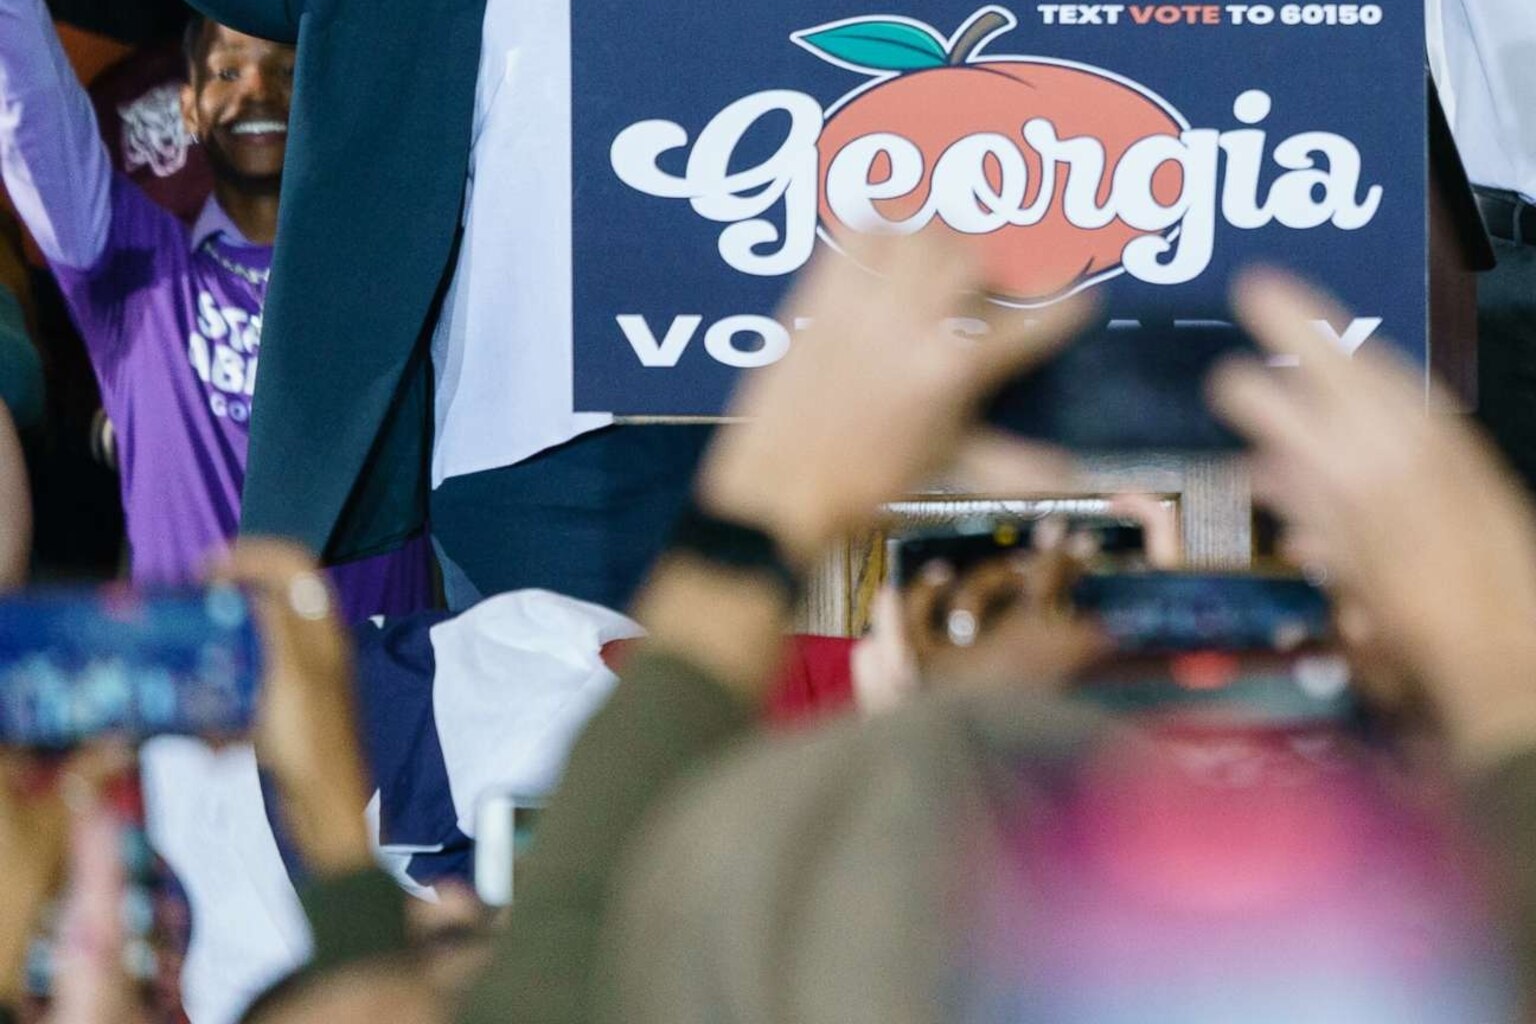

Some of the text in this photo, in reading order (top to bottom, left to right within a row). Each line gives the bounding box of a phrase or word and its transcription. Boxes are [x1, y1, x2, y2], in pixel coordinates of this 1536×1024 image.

[1037, 4, 1383, 25] TEXT VOTE TO 60150
[609, 88, 1384, 287] Georgia
